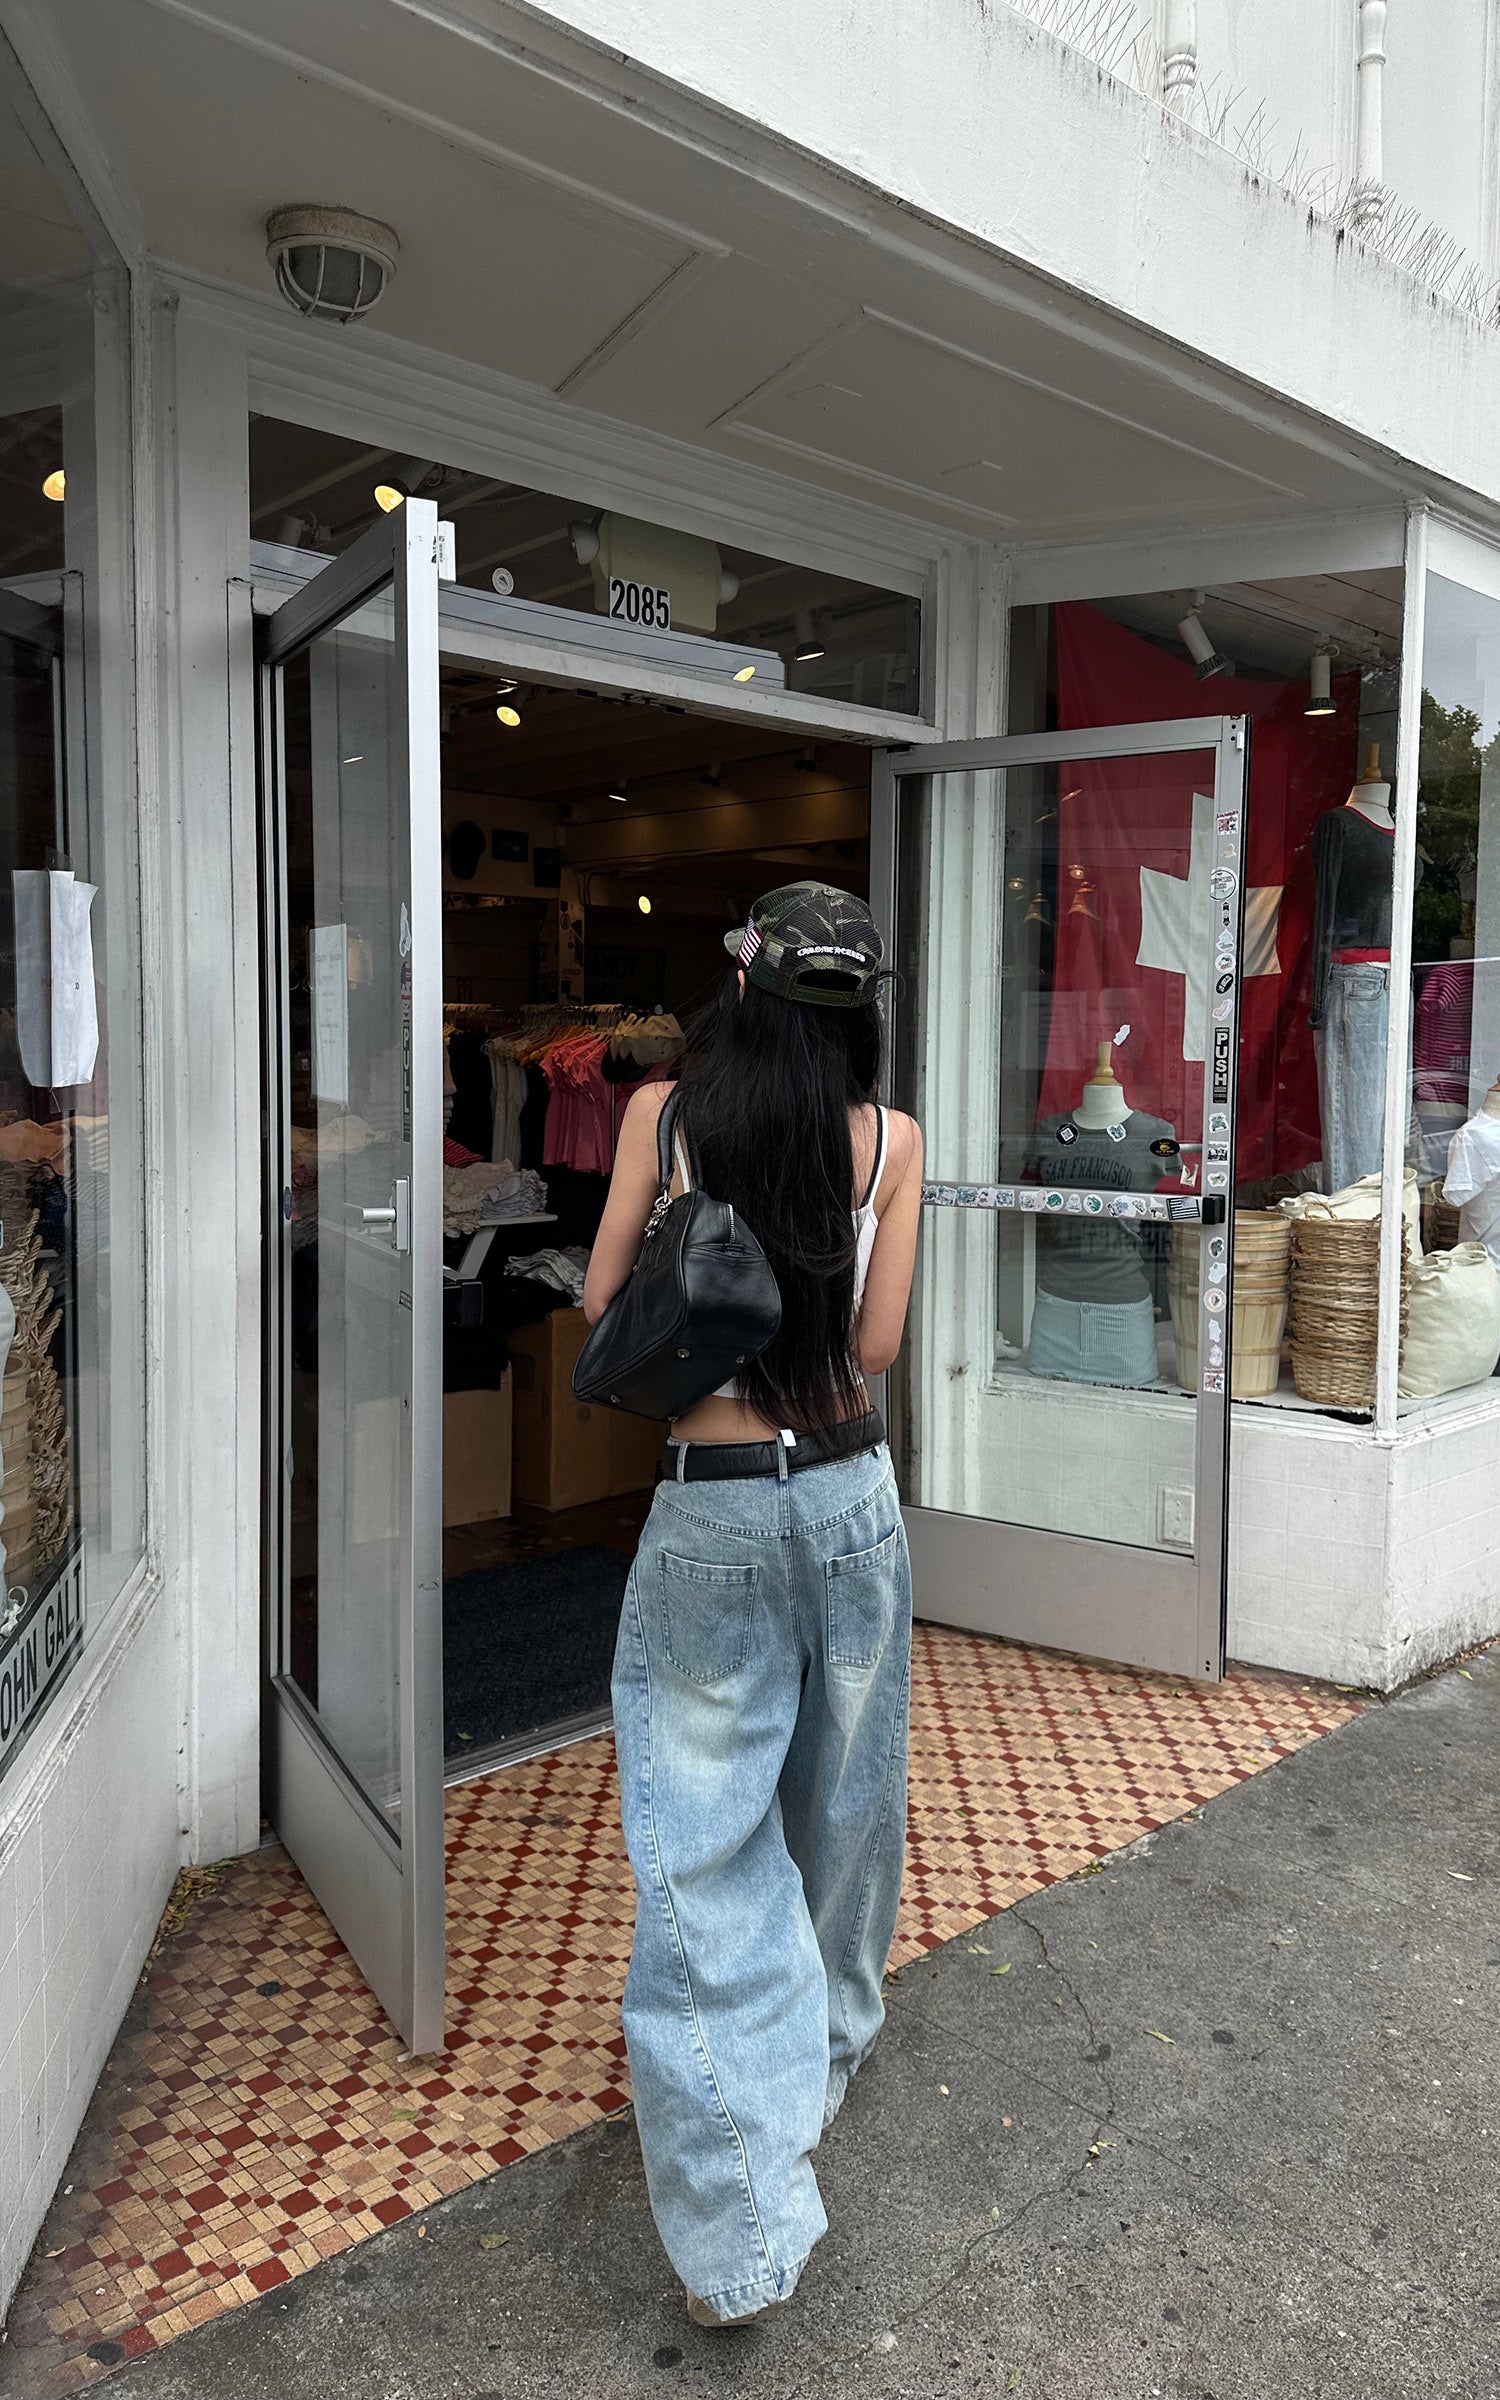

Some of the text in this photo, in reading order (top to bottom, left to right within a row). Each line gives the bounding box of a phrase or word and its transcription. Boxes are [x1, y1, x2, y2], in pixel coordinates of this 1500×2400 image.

[611, 579, 669, 629] 2085
[1214, 1032, 1228, 1086] PUSH
[1045, 1157, 1133, 1191] SAN FRANCISCO
[45, 1560, 82, 1668] GALT
